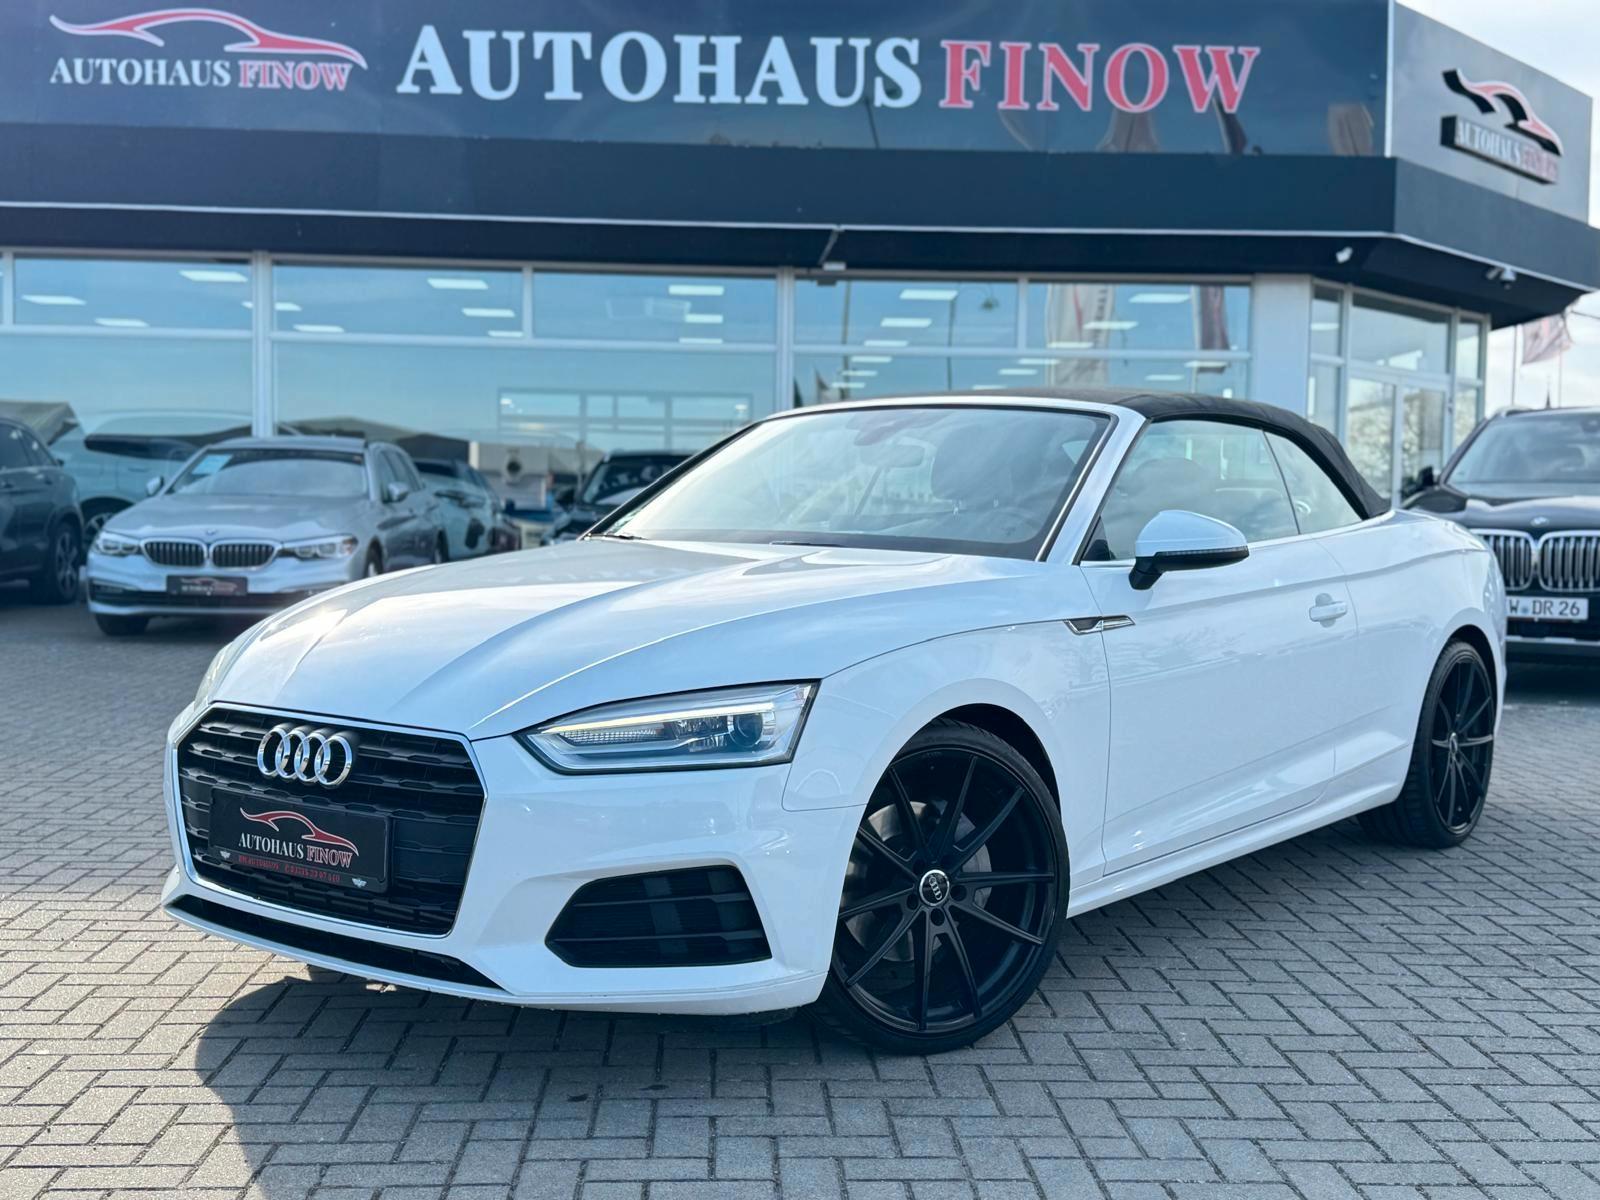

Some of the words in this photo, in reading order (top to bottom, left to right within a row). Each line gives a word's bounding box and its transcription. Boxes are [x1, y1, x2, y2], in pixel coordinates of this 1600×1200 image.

[49, 56, 232, 88] AUTOHAUS
[236, 59, 353, 92] FINOW
[396, 25, 921, 108] AUTOHAUS
[939, 39, 1261, 113] FINOW
[1532, 599, 1554, 616] DR
[1558, 600, 1581, 617] 26
[238, 832, 304, 860] AUTOHAUS
[306, 845, 353, 868] FINOW
